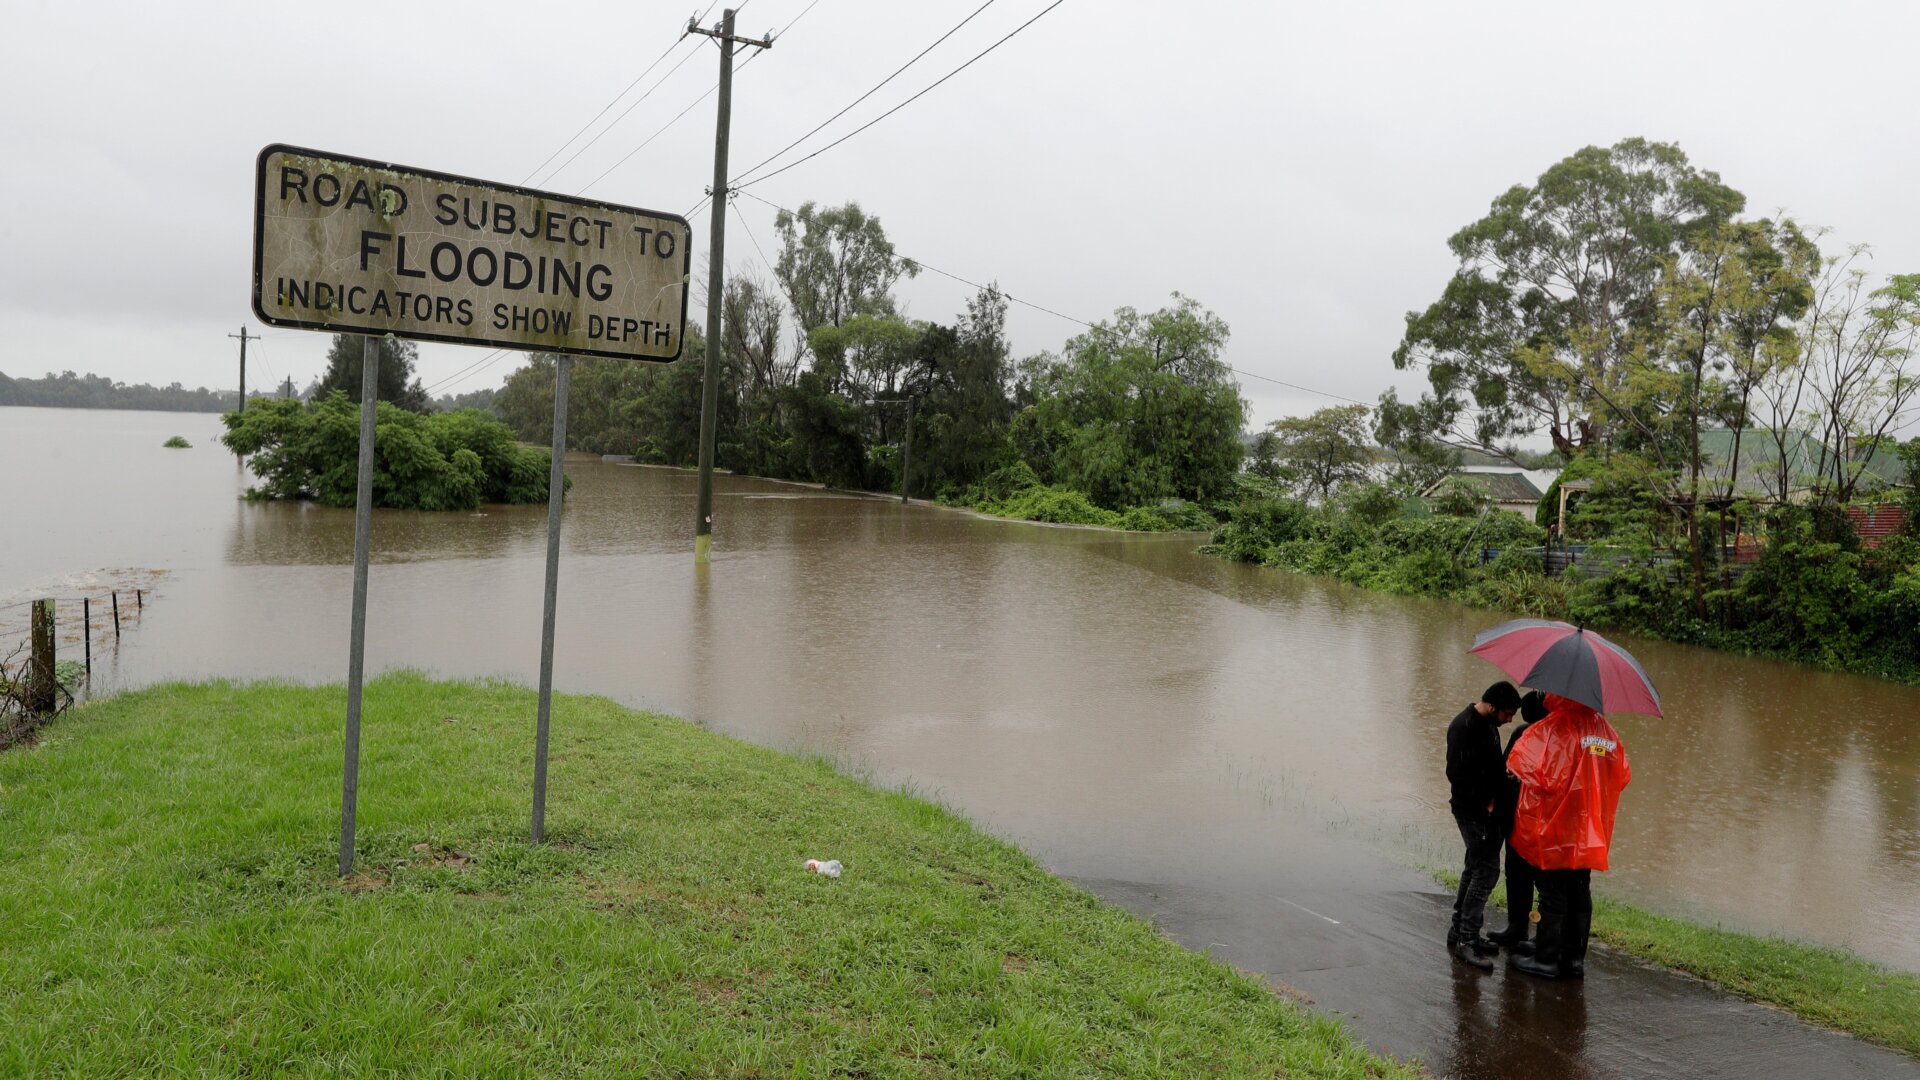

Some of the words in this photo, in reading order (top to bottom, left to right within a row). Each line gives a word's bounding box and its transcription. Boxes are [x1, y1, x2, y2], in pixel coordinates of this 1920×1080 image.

[280, 166, 408, 217] ROAD
[434, 193, 613, 249] SUBJECT
[634, 226, 675, 259] TO
[360, 230, 613, 302] FLOODING
[277, 277, 473, 326] INDICATORS
[493, 303, 571, 336] SHOW
[588, 314, 670, 347] DEPTH
